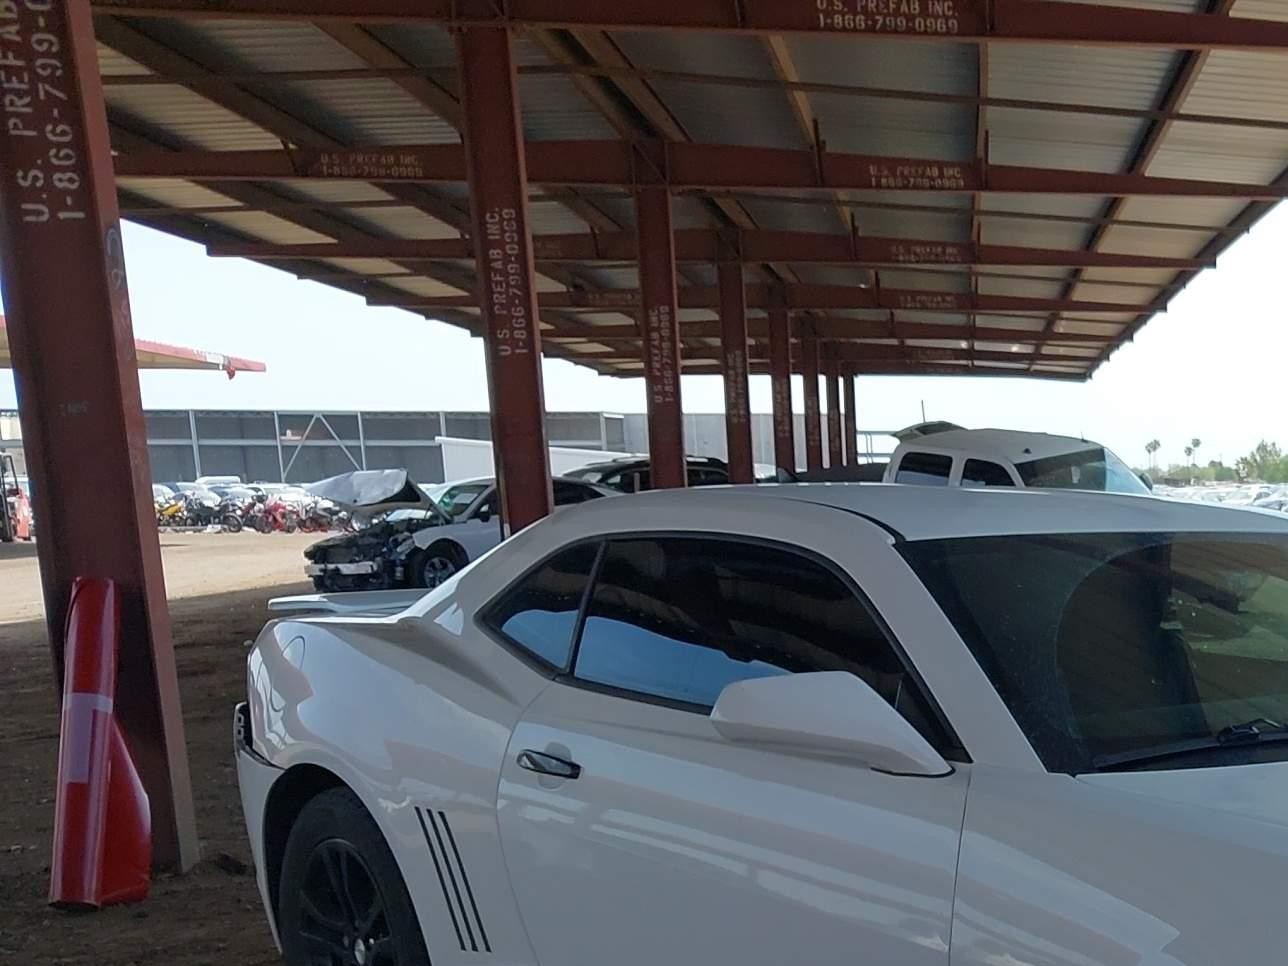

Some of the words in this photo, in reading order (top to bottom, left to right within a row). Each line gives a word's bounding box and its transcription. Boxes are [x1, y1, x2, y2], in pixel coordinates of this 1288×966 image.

[817, 0, 848, 11] U.S.
[857, 0, 920, 14] PREFAB
[928, 0, 959, 16] INC.
[818, 13, 959, 33] 1-866-799-0969
[17, 159, 50, 222] U.S.
[485, 207, 501, 240] INC.
[488, 249, 507, 314] PREFAB
